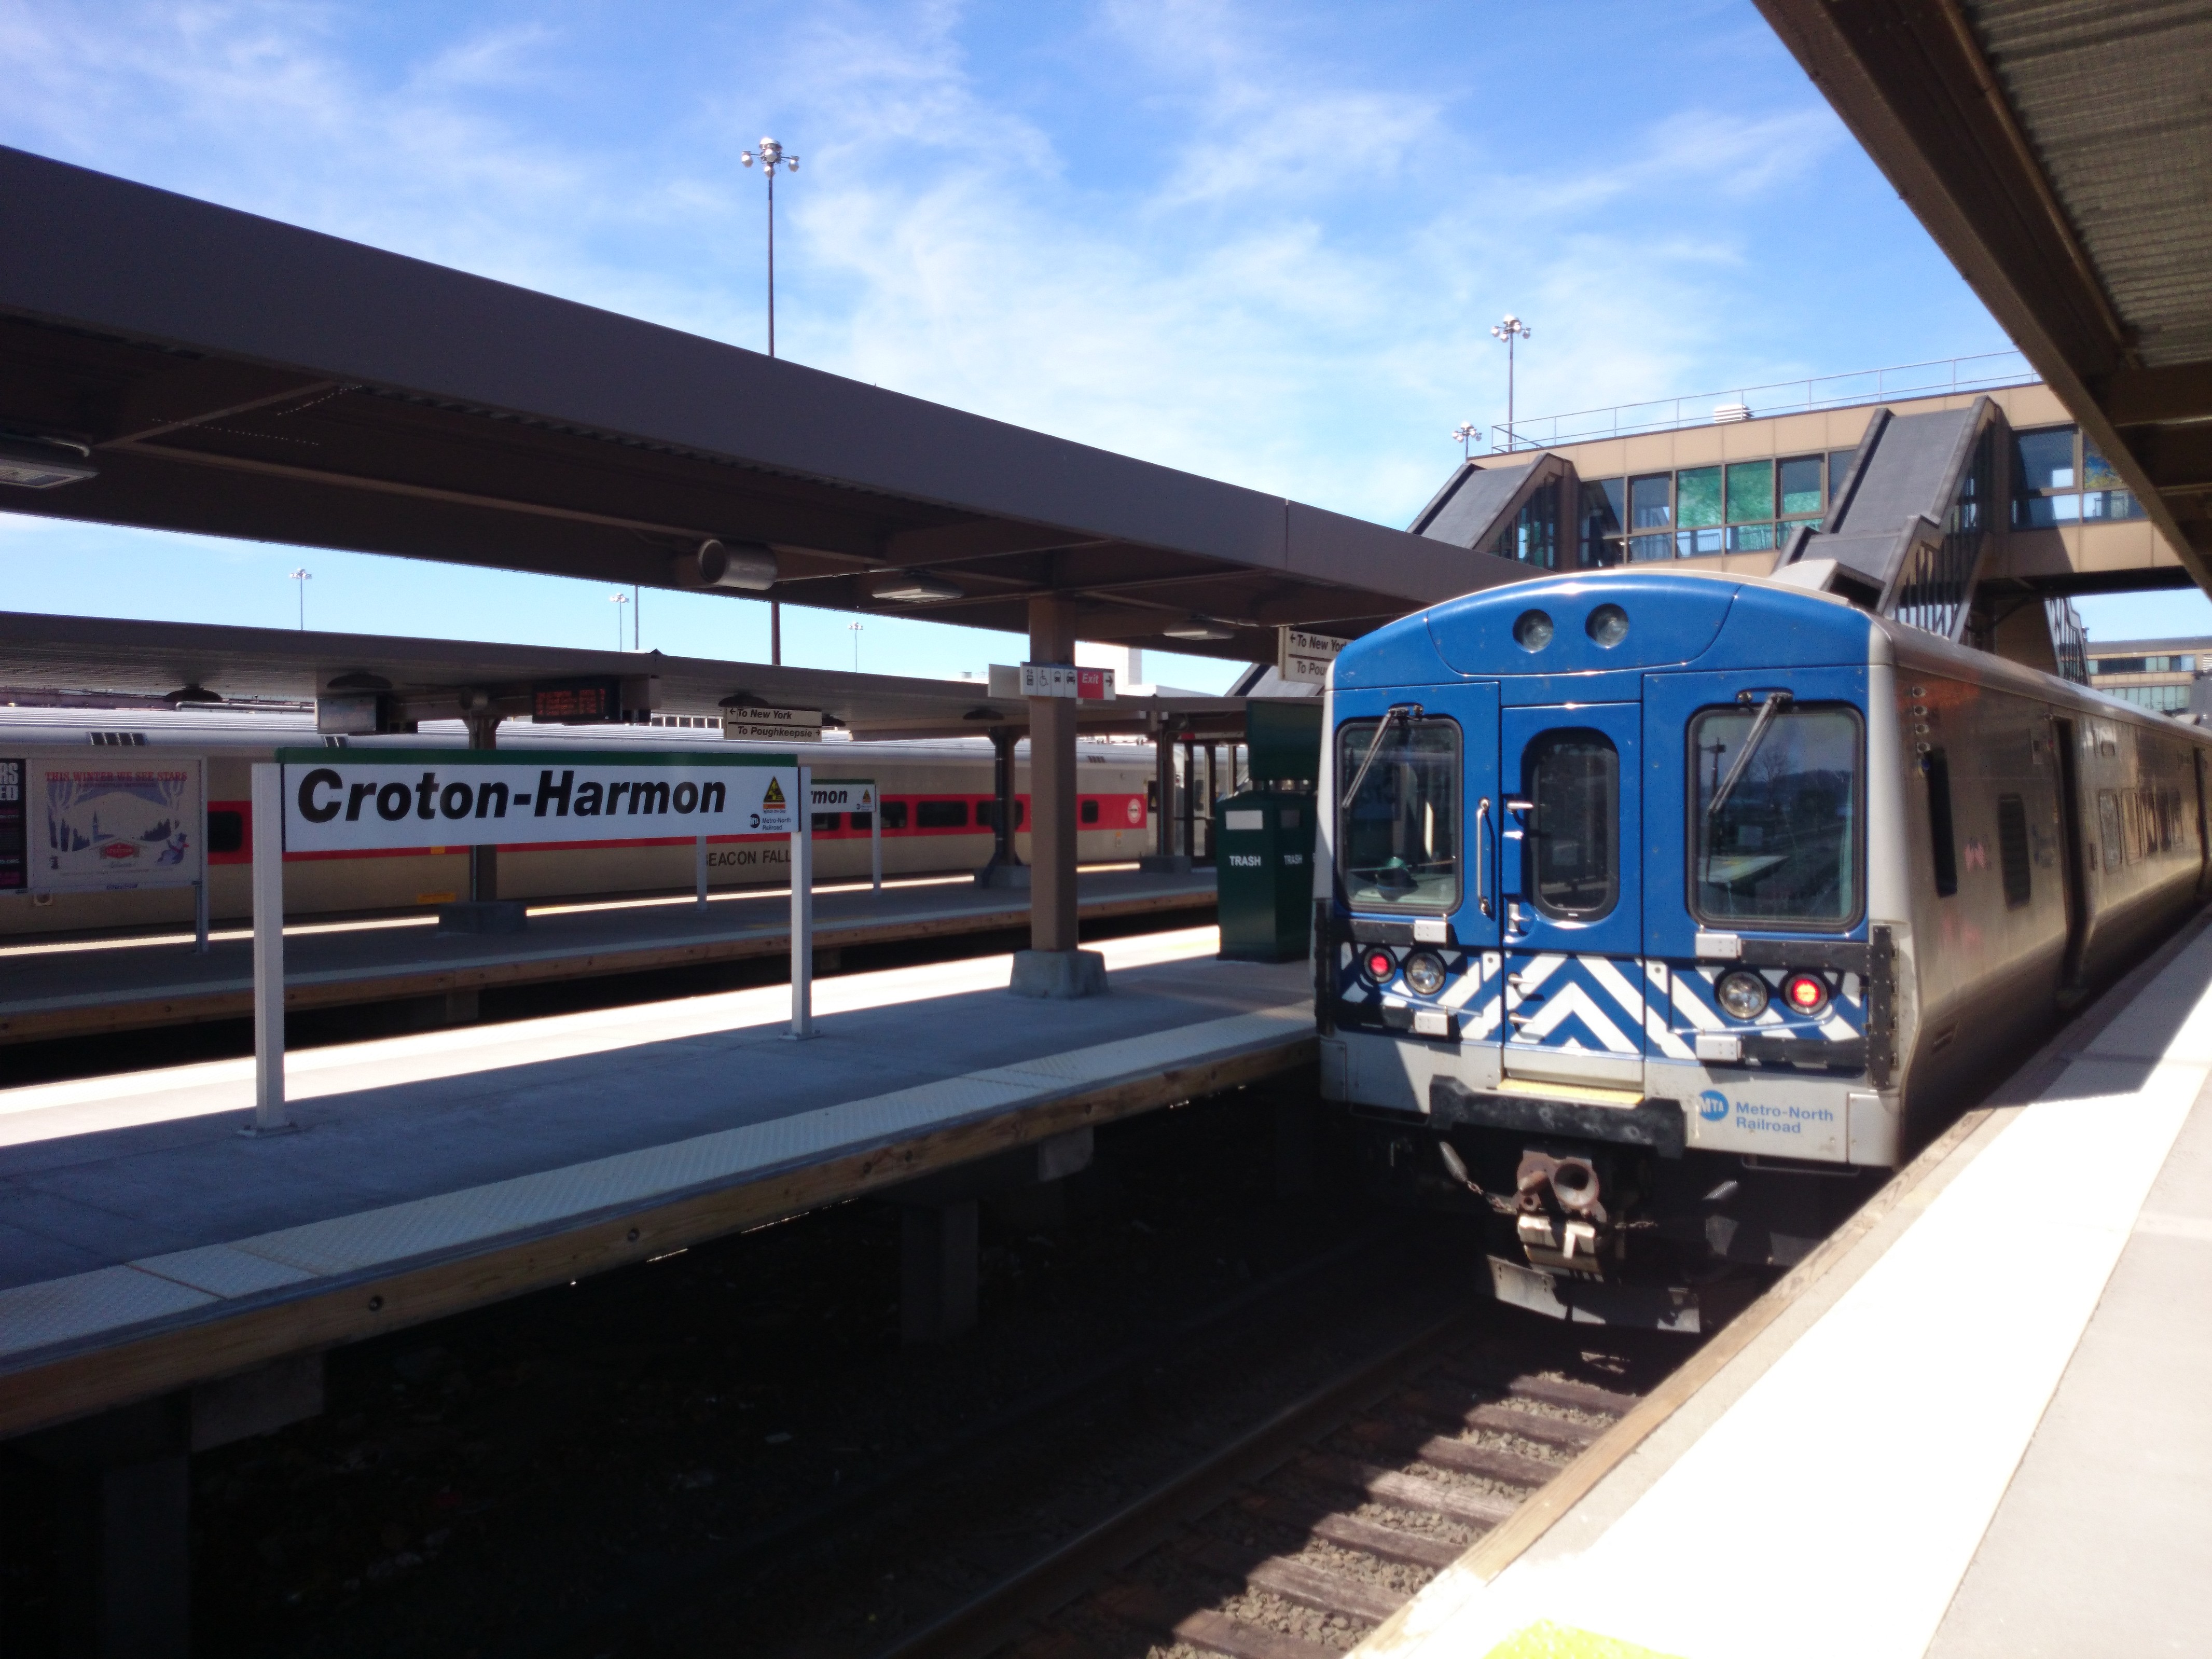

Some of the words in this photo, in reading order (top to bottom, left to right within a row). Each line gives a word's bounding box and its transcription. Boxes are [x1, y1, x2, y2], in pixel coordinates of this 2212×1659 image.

[1297, 634, 1307, 647] To
[1309, 636, 1328, 650] New
[1331, 639, 1347, 652] Yor
[1297, 661, 1306, 673] To
[1082, 673, 1099, 684] Exit
[738, 709, 748, 717] To
[750, 709, 770, 718] New
[774, 711, 792, 720] York
[738, 726, 748, 735] To
[751, 727, 812, 739] Poughkeepsie
[45, 772, 70, 782] THIS
[73, 772, 113, 781] WINTER
[117, 772, 132, 781] WE
[136, 772, 154, 781] SEE
[157, 772, 187, 781] STARS
[298, 768, 727, 823] Croton-Harmon
[707, 851, 756, 867] EACON
[1229, 855, 1262, 867] TRASH
[1284, 854, 1303, 866] TRASH
[1736, 1102, 1834, 1122] Metro-North
[1736, 1116, 1801, 1133] Railroad
